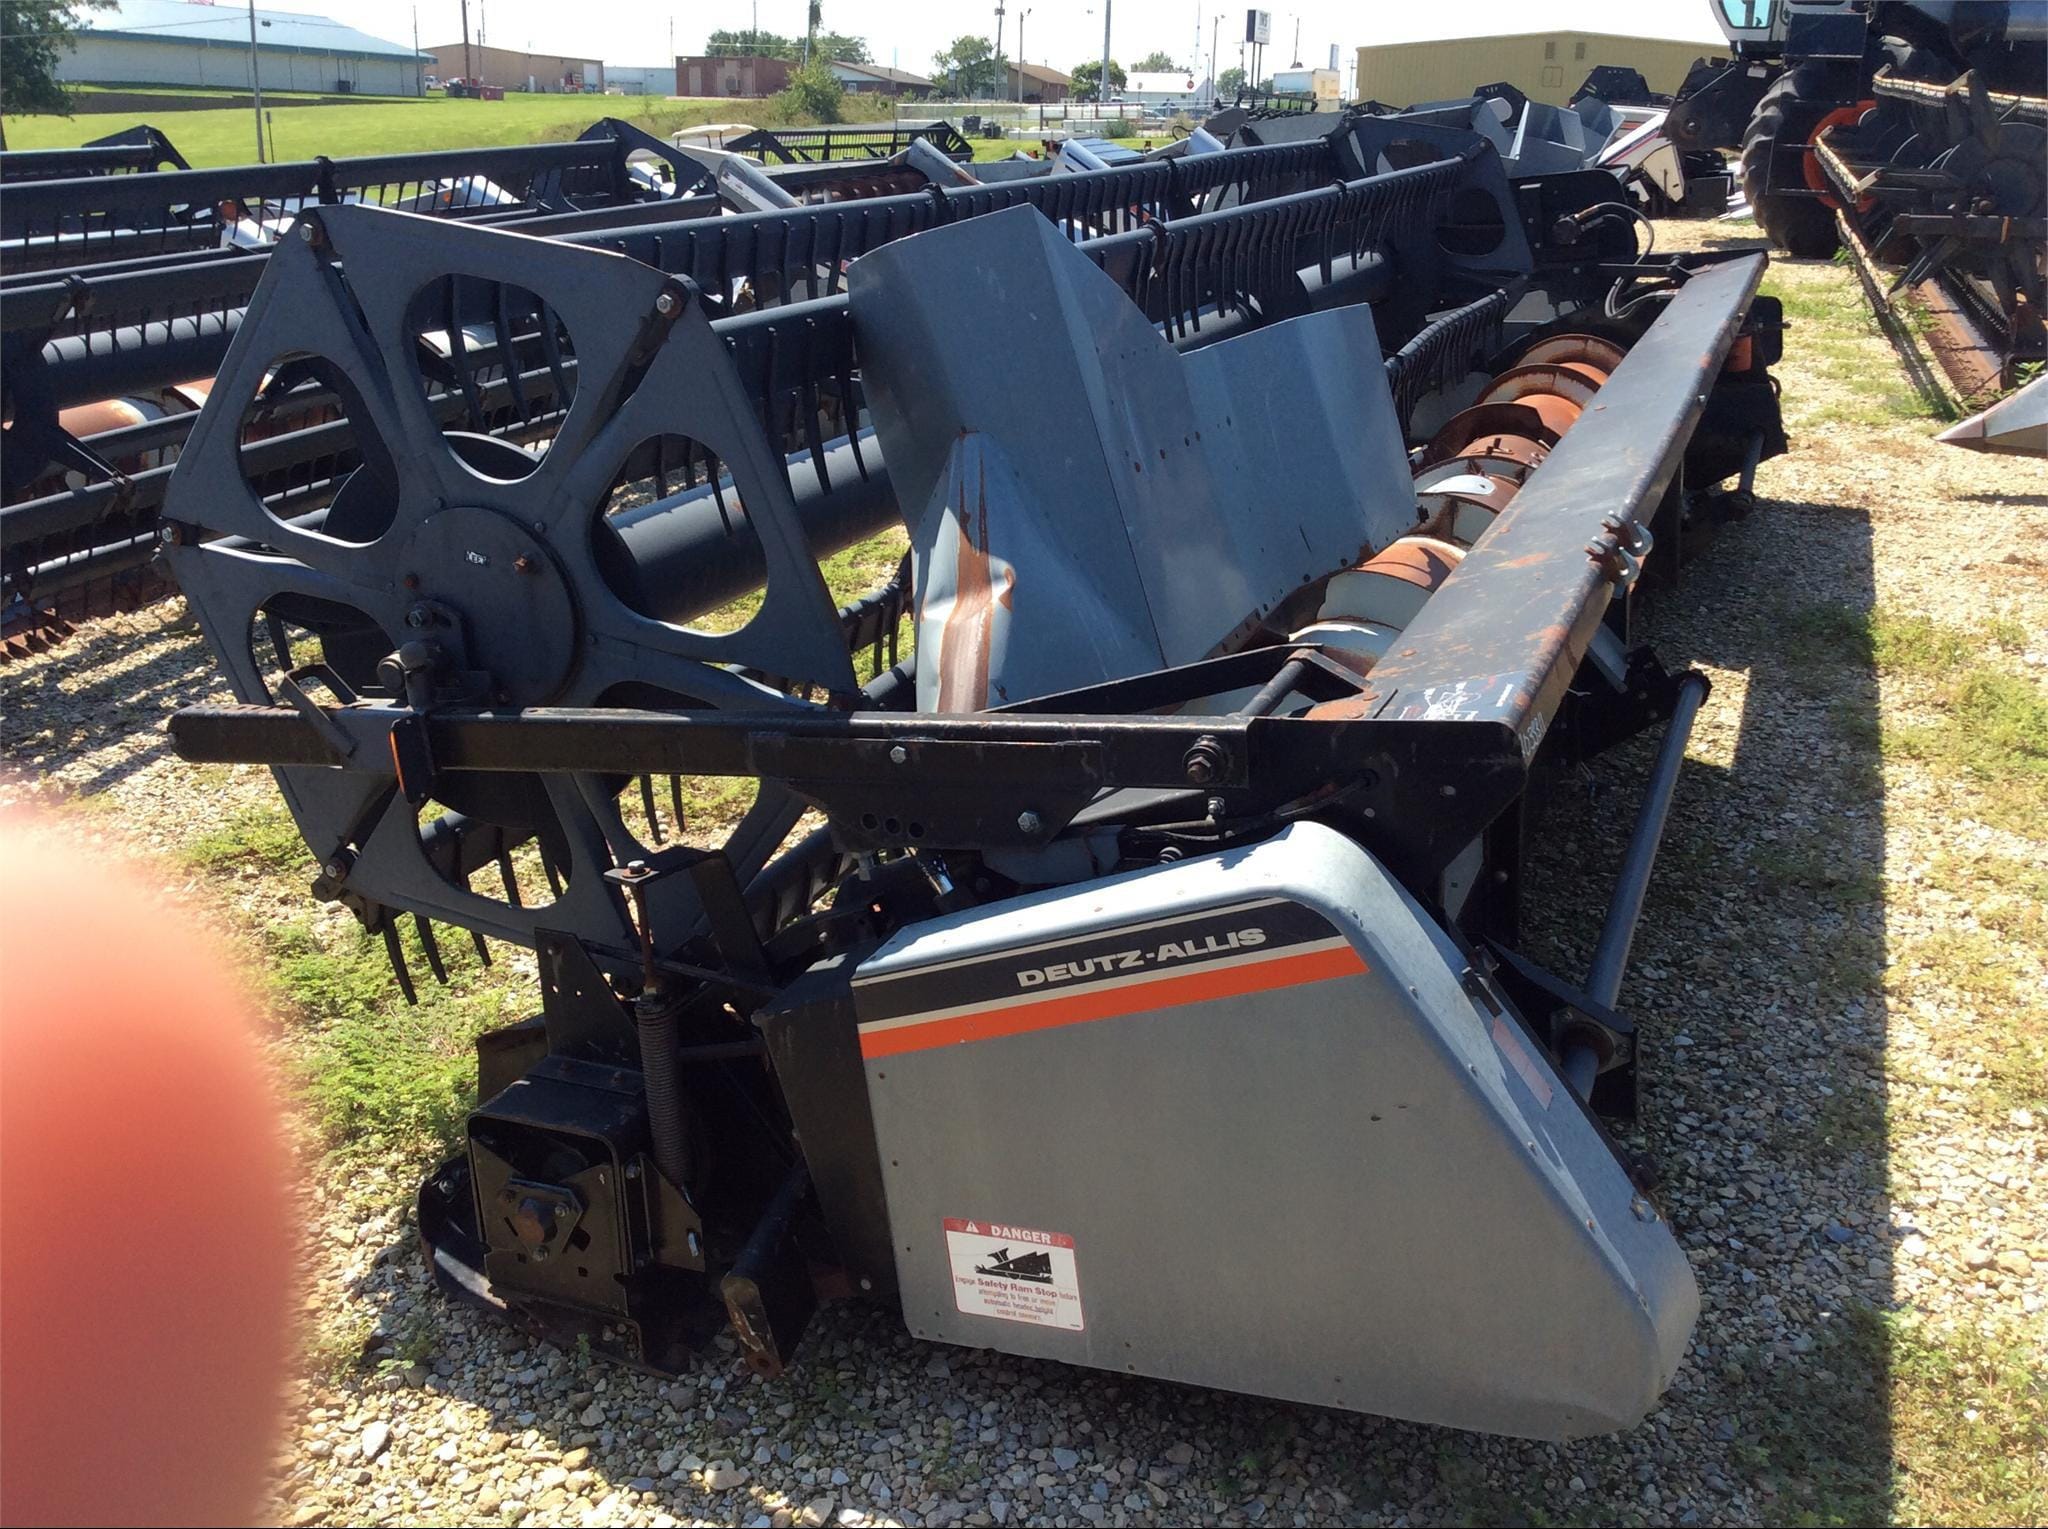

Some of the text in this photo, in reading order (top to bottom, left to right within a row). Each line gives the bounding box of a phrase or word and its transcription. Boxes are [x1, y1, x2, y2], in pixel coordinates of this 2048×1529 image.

[1016, 927, 1267, 988] DEUTZ-ALLIS
[991, 1225, 1051, 1245] DANGER
[977, 1278, 1008, 1291] Safety
[1011, 1283, 1032, 1294] Ram
[1035, 1286, 1057, 1298] Stop
